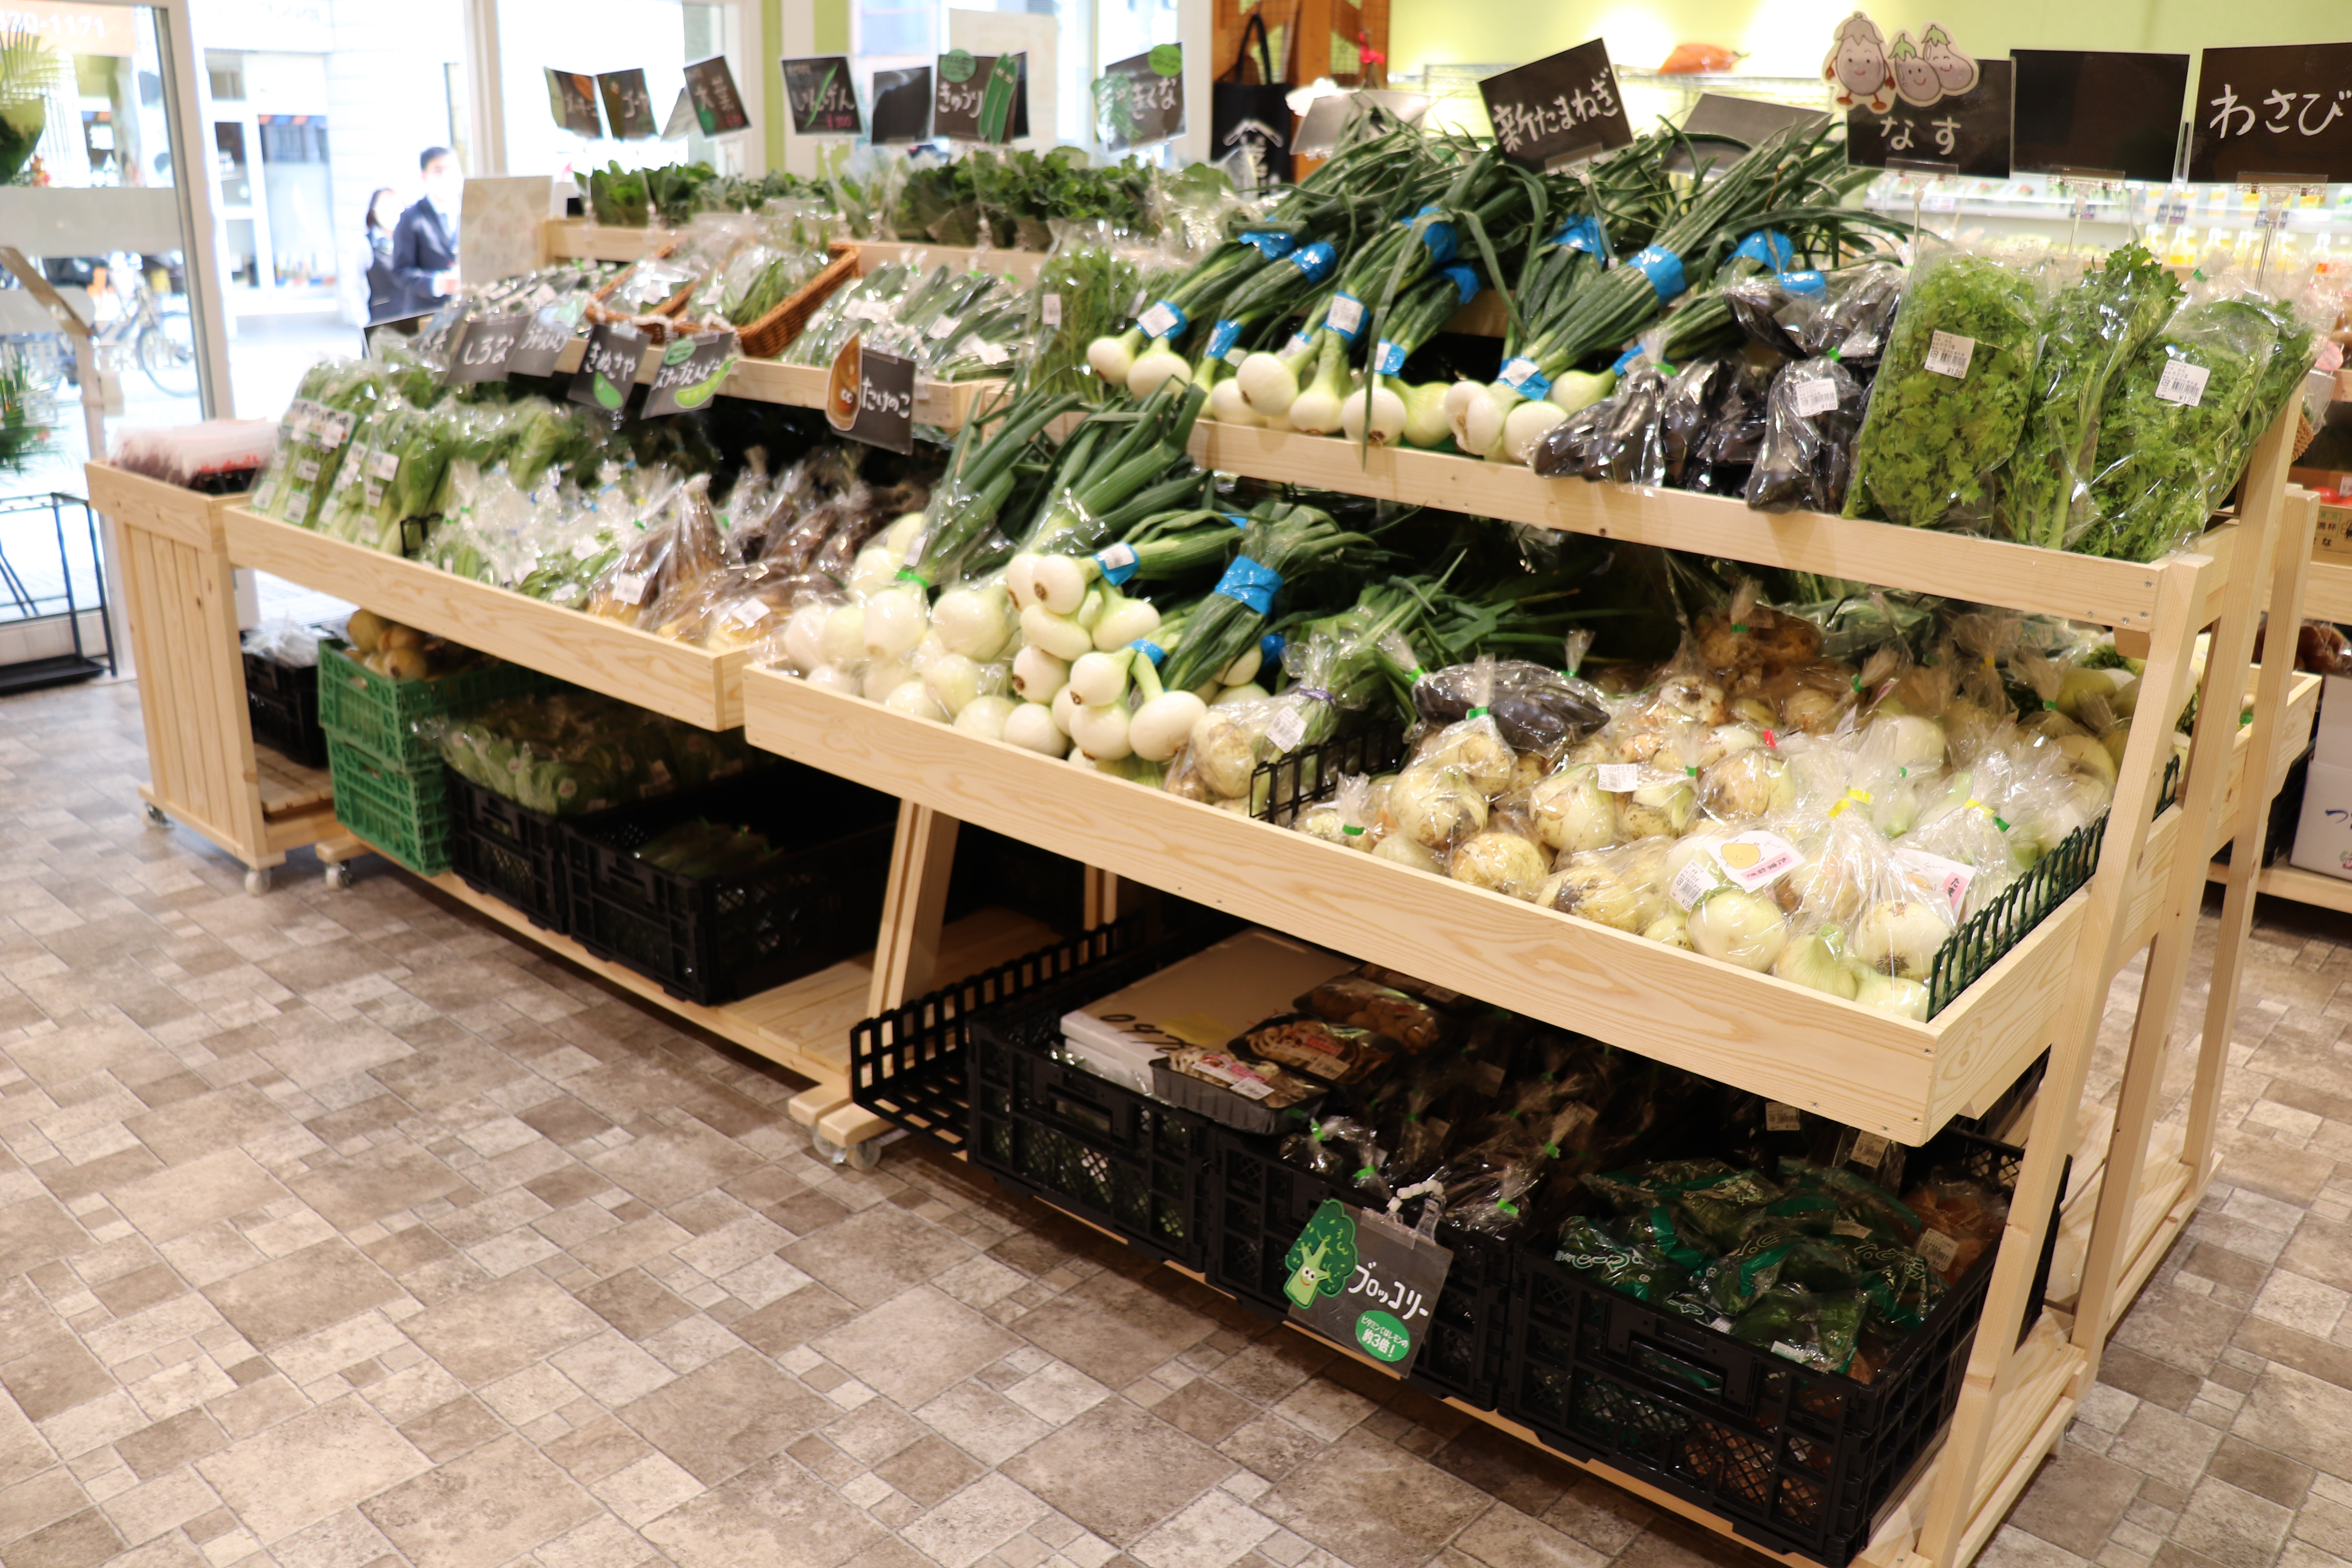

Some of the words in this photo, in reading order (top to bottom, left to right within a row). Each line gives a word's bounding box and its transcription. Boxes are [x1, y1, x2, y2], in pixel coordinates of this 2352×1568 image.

[938, 81, 984, 119] きゅうり
[1492, 68, 1619, 153] 新たまねぎ
[2209, 83, 2352, 138] わさび
[1880, 115, 1961, 155] なす
[463, 334, 515, 365] しろな
[584, 341, 636, 381] きぬさや
[1947, 367, 1963, 377] ¥120
[861, 376, 911, 419] たけのこ
[2179, 394, 2196, 404] ¥120
[1947, 877, 1960, 897] たま
[1347, 1261, 1429, 1320] ブロッコリー
[1361, 1328, 1396, 1358] 約3倍!
